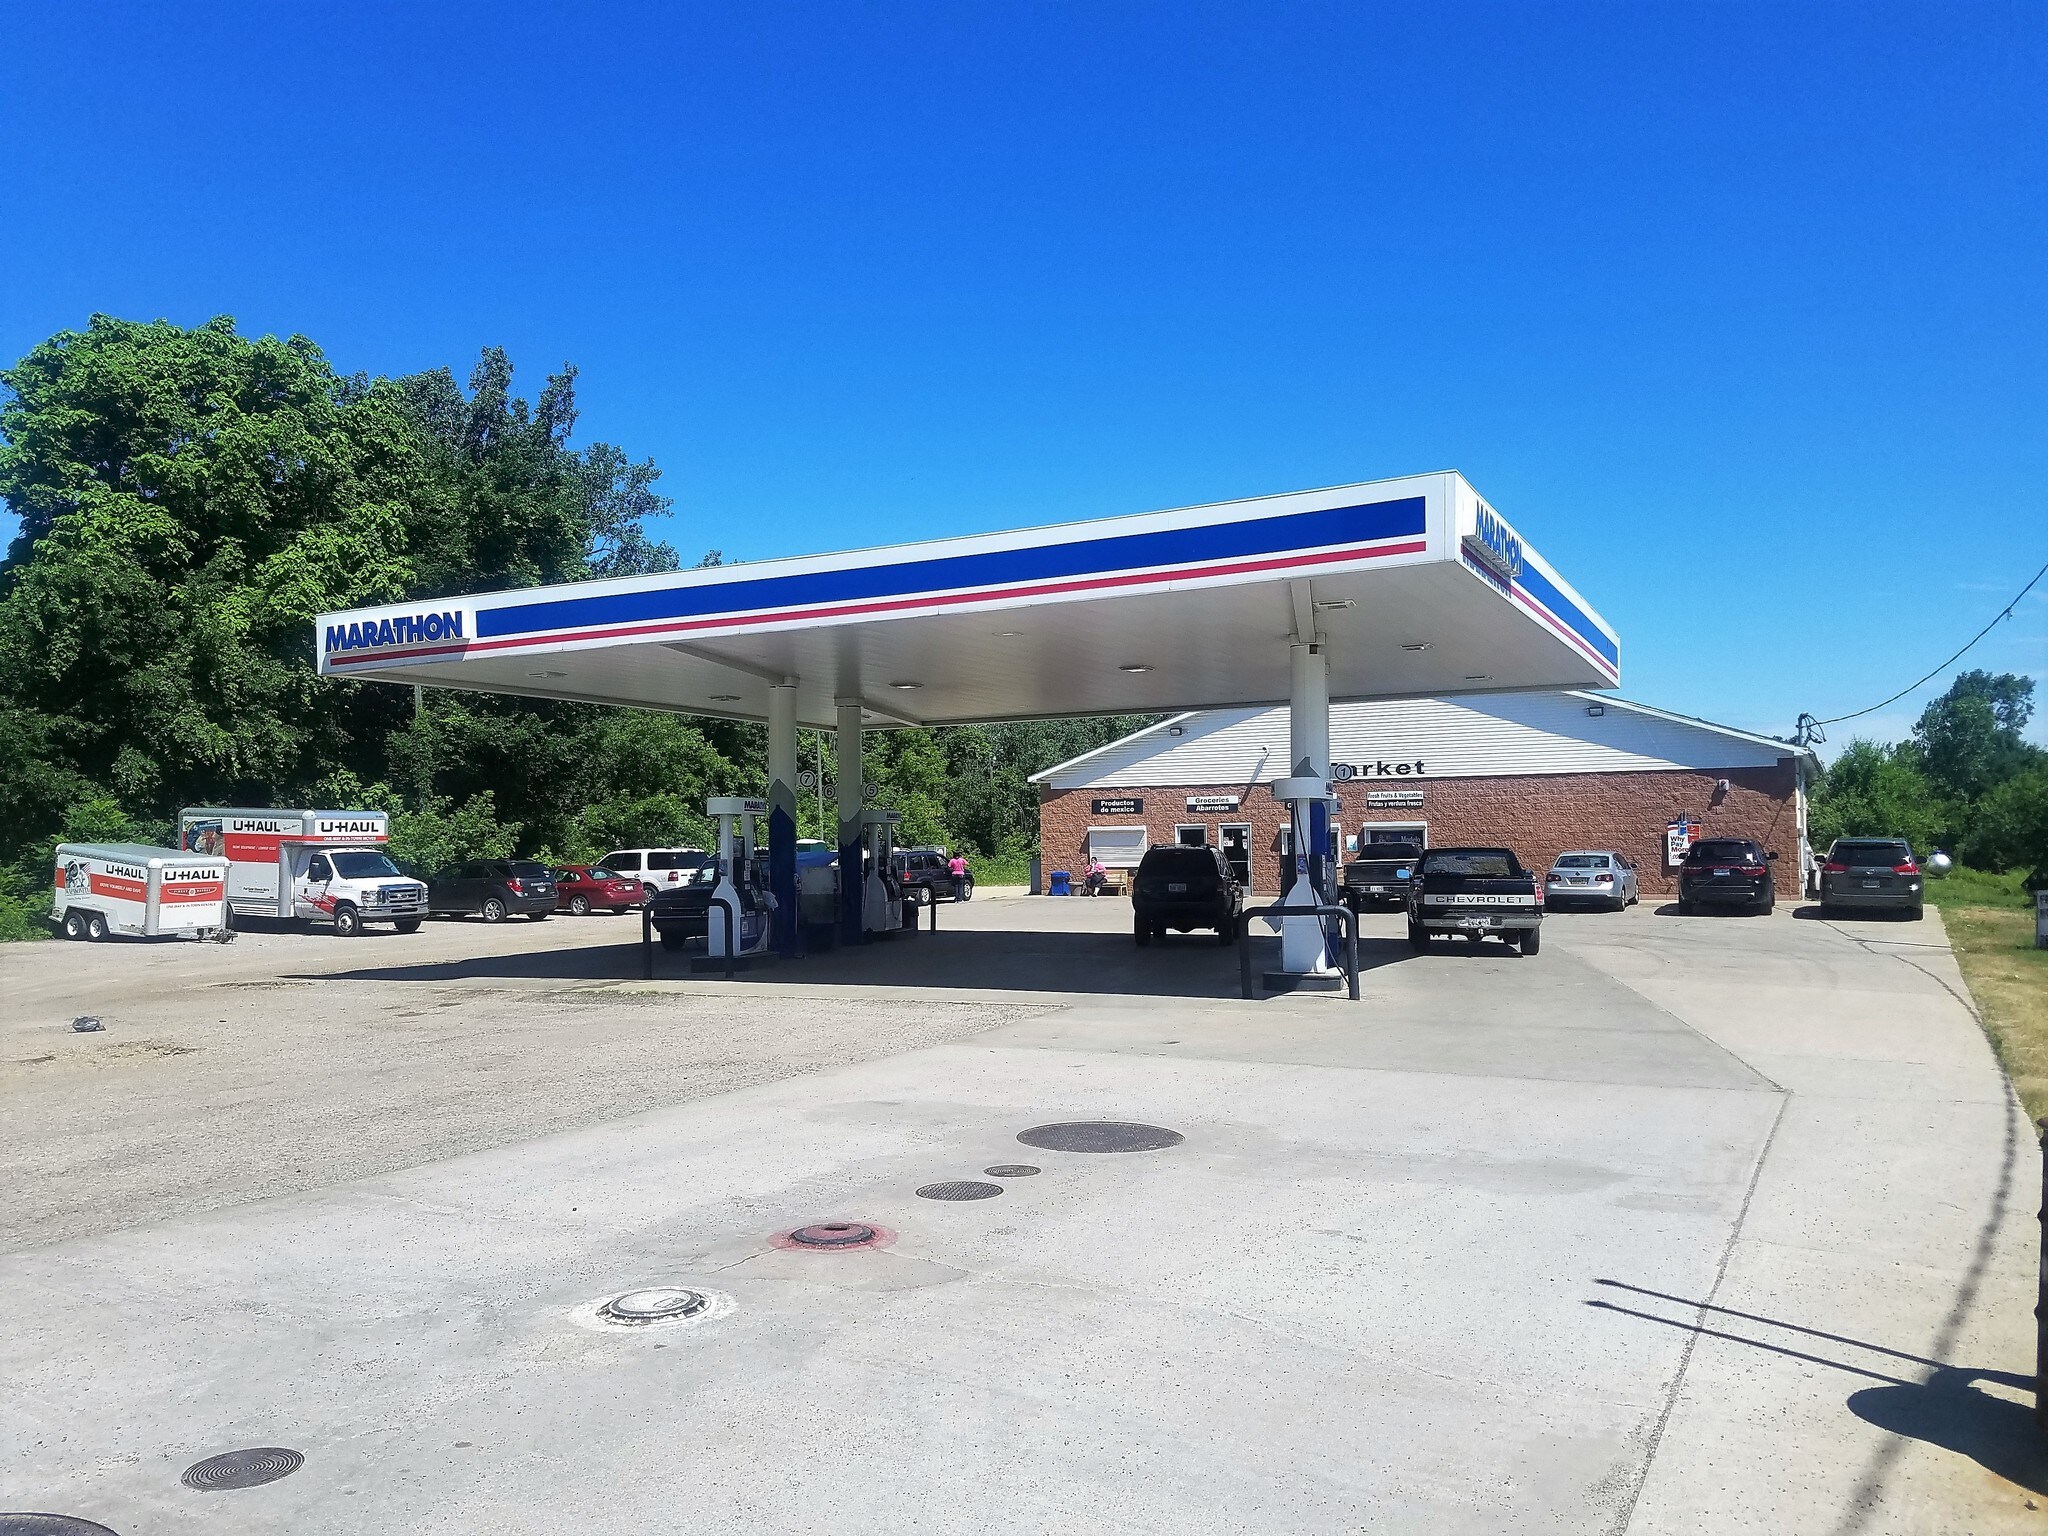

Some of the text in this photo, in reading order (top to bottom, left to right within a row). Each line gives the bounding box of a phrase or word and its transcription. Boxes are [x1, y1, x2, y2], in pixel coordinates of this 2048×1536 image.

[1476, 499, 1522, 575] MARATHON
[325, 611, 463, 652] MARATHON
[233, 820, 280, 832] U-HAUL
[321, 822, 379, 832] U-HAUL
[105, 864, 144, 879] U-HAUL
[165, 870, 219, 880] U-HAUL
[1435, 896, 1524, 904] CHEVROLET
